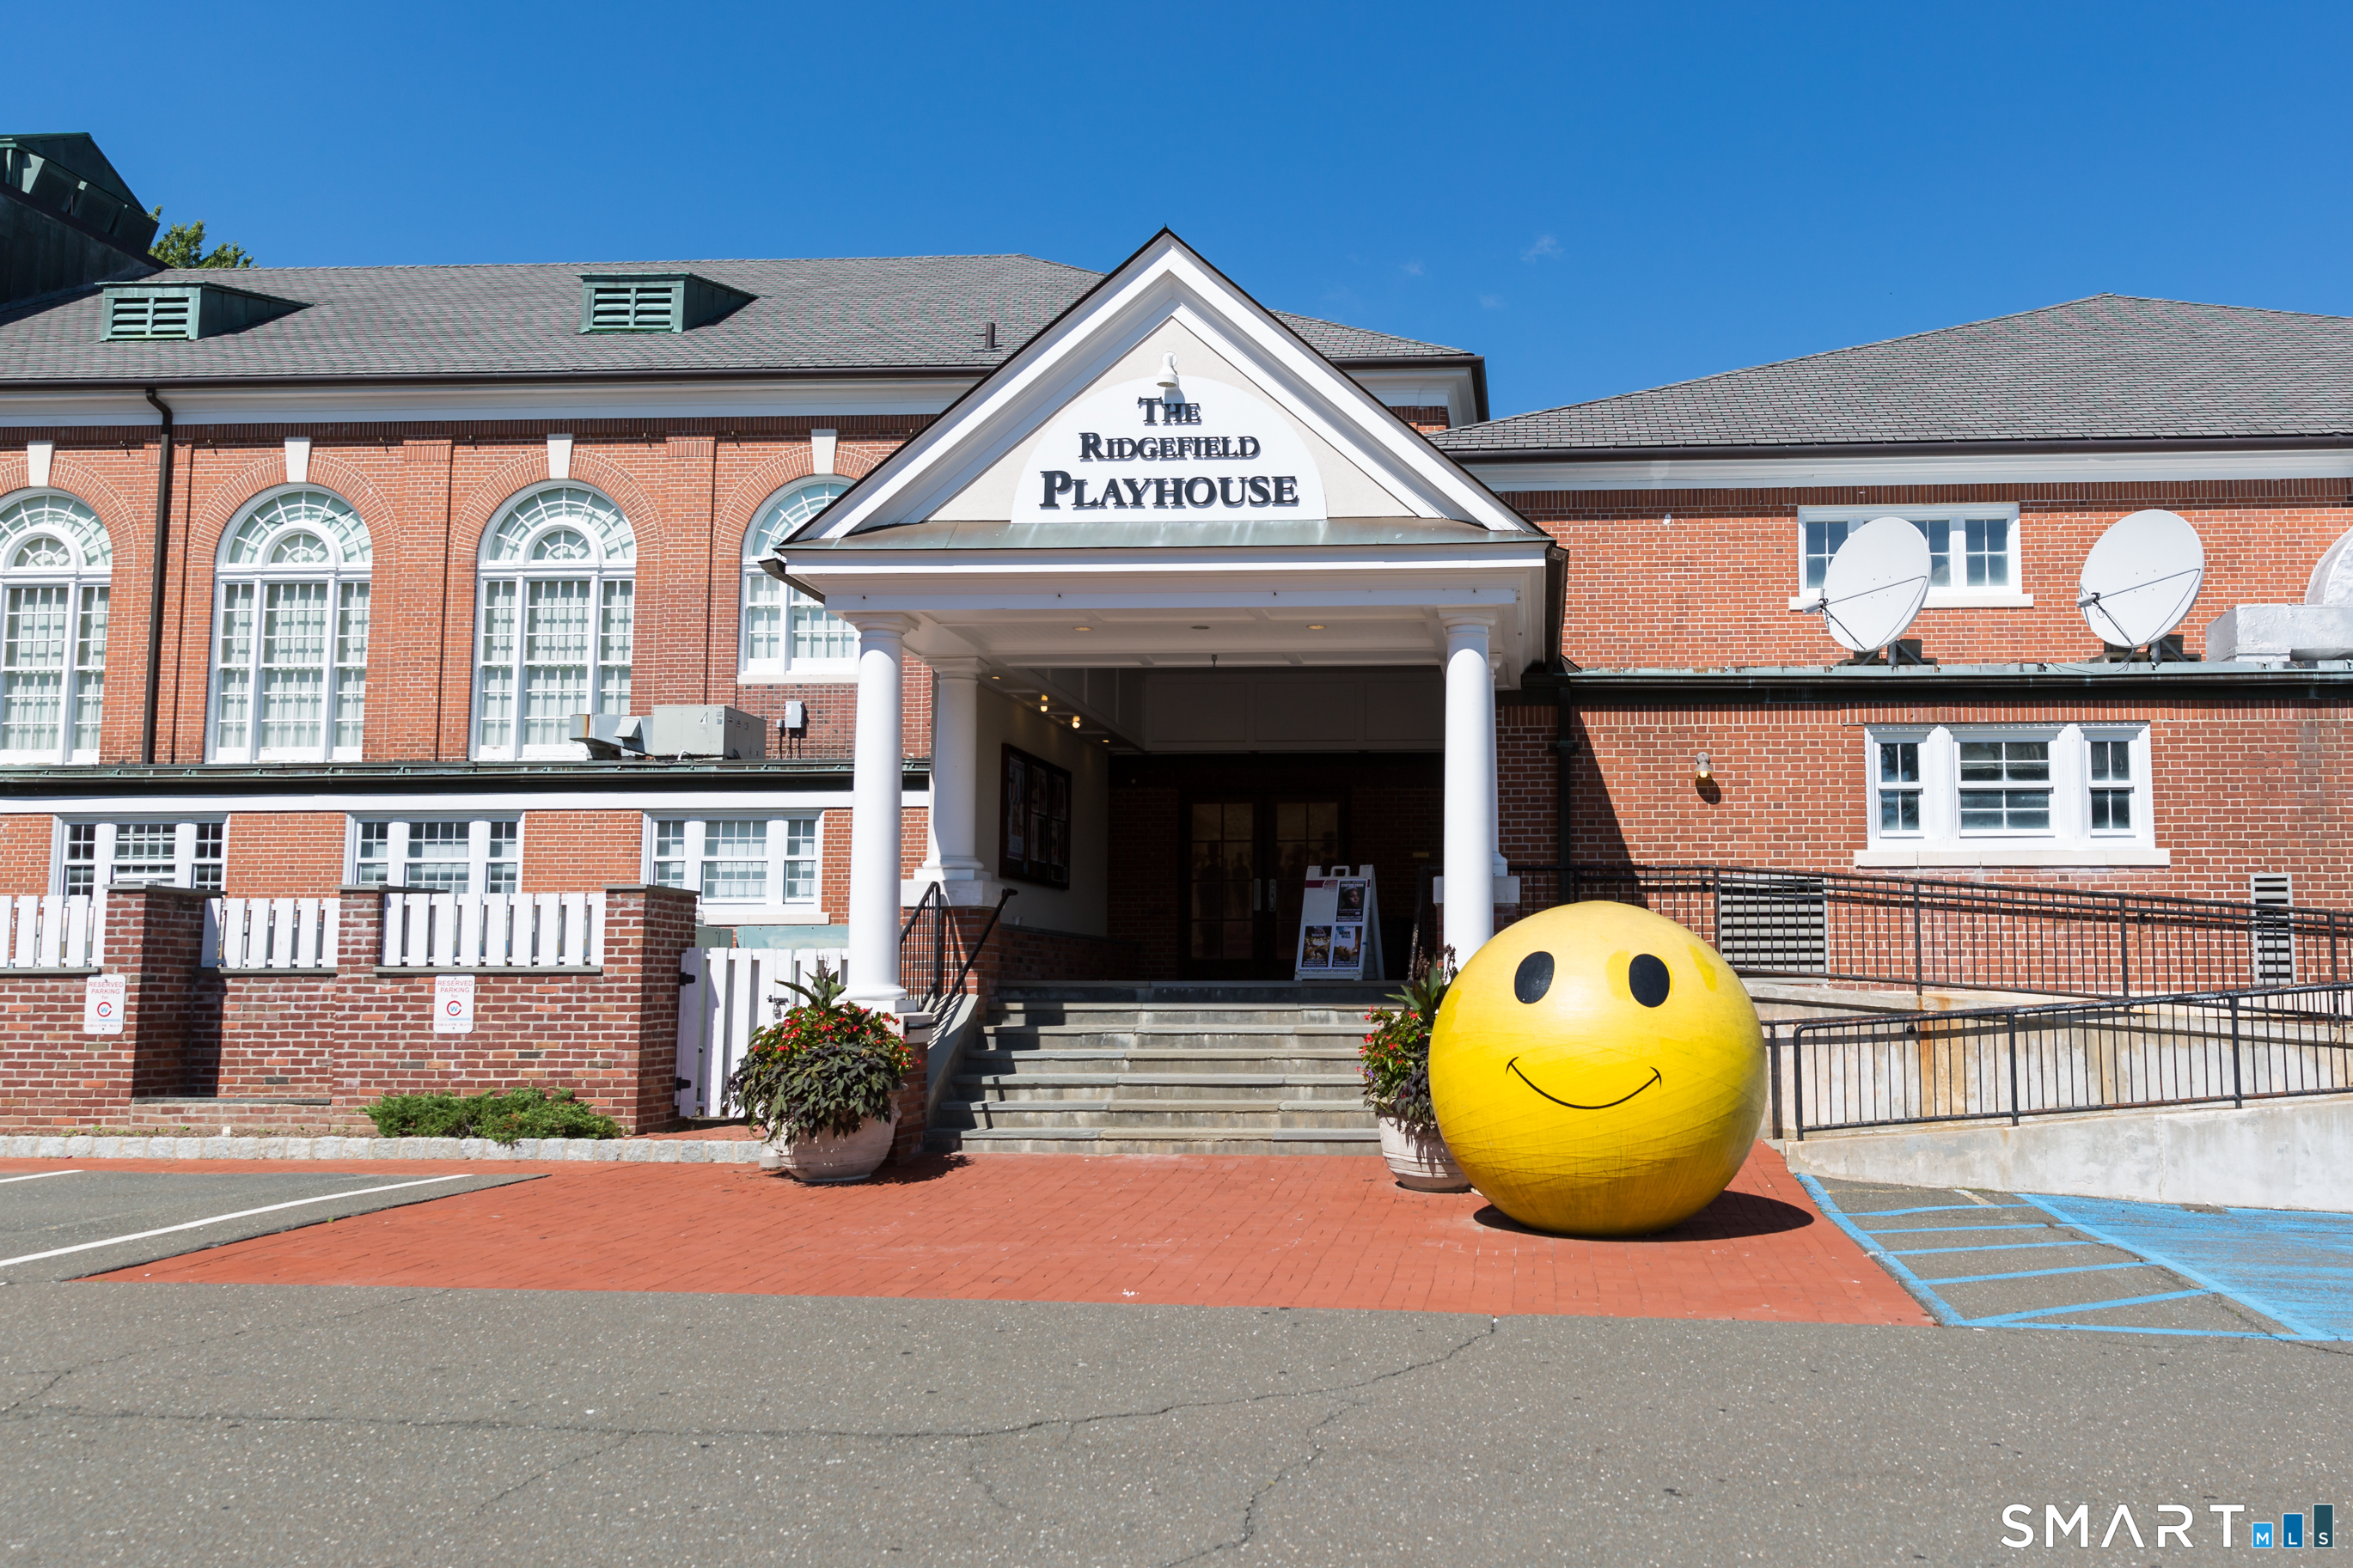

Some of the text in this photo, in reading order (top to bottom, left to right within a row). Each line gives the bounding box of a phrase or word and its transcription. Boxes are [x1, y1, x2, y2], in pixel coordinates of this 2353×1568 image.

[1138, 396, 1201, 424] THE
[1078, 432, 1261, 461] RIDGEFIELD
[1039, 470, 1299, 509] PLAYHOUSE
